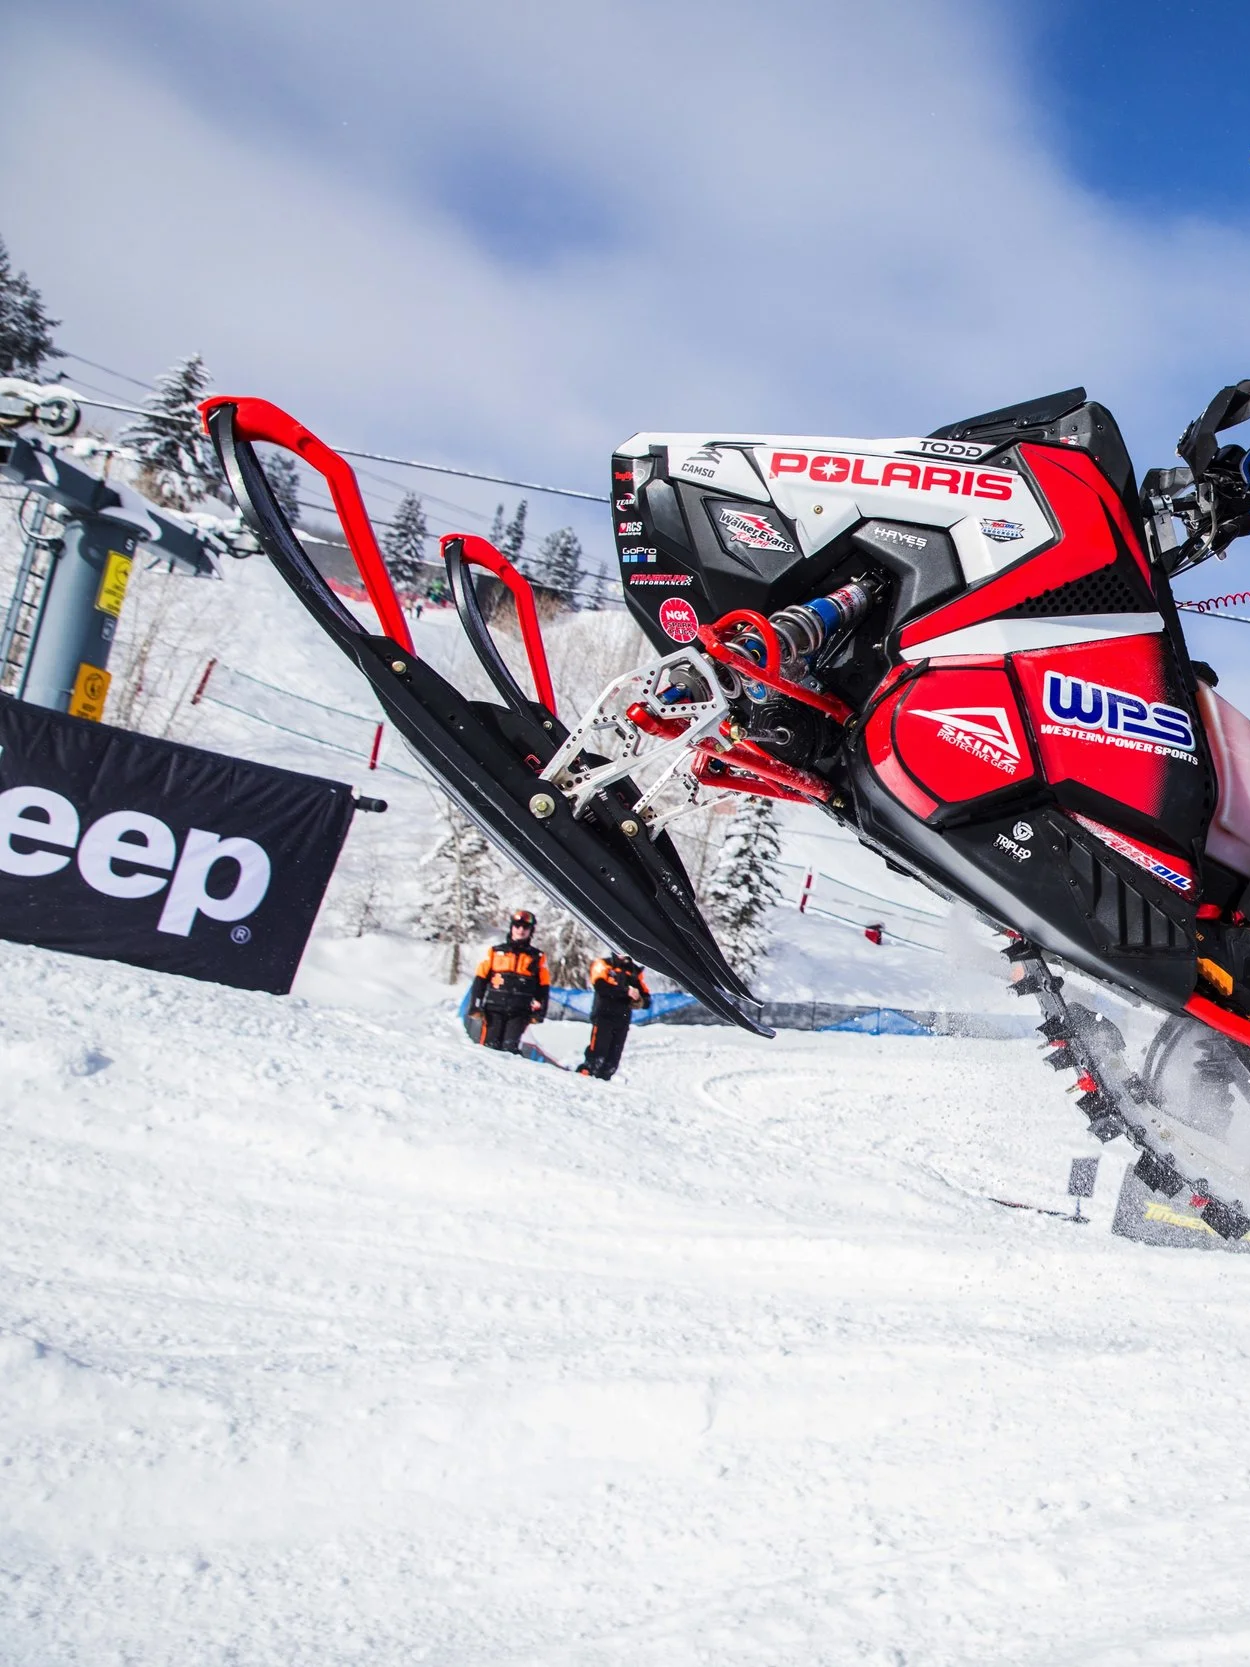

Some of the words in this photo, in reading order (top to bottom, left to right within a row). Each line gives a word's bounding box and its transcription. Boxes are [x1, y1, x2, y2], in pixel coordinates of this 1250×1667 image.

[920, 441, 983, 458] TODD
[681, 463, 716, 478] CAMSO
[769, 451, 1014, 501] POLARIS
[625, 522, 643, 532] RCS
[874, 527, 928, 547] HAYES
[665, 610, 691, 621] NGK
[669, 629, 696, 637] PLUGS
[1045, 672, 1195, 750] WPS
[936, 728, 990, 763] PROTECTIVE
[990, 758, 1017, 776] GEAR
[941, 723, 1020, 770] SKINZ
[1040, 724, 1105, 743] WESTERN
[1105, 734, 1154, 752] POWER
[1154, 745, 1199, 766] SPORTS
[996, 833, 1032, 860] TRIPLE9
[0, 784, 271, 937] eep
